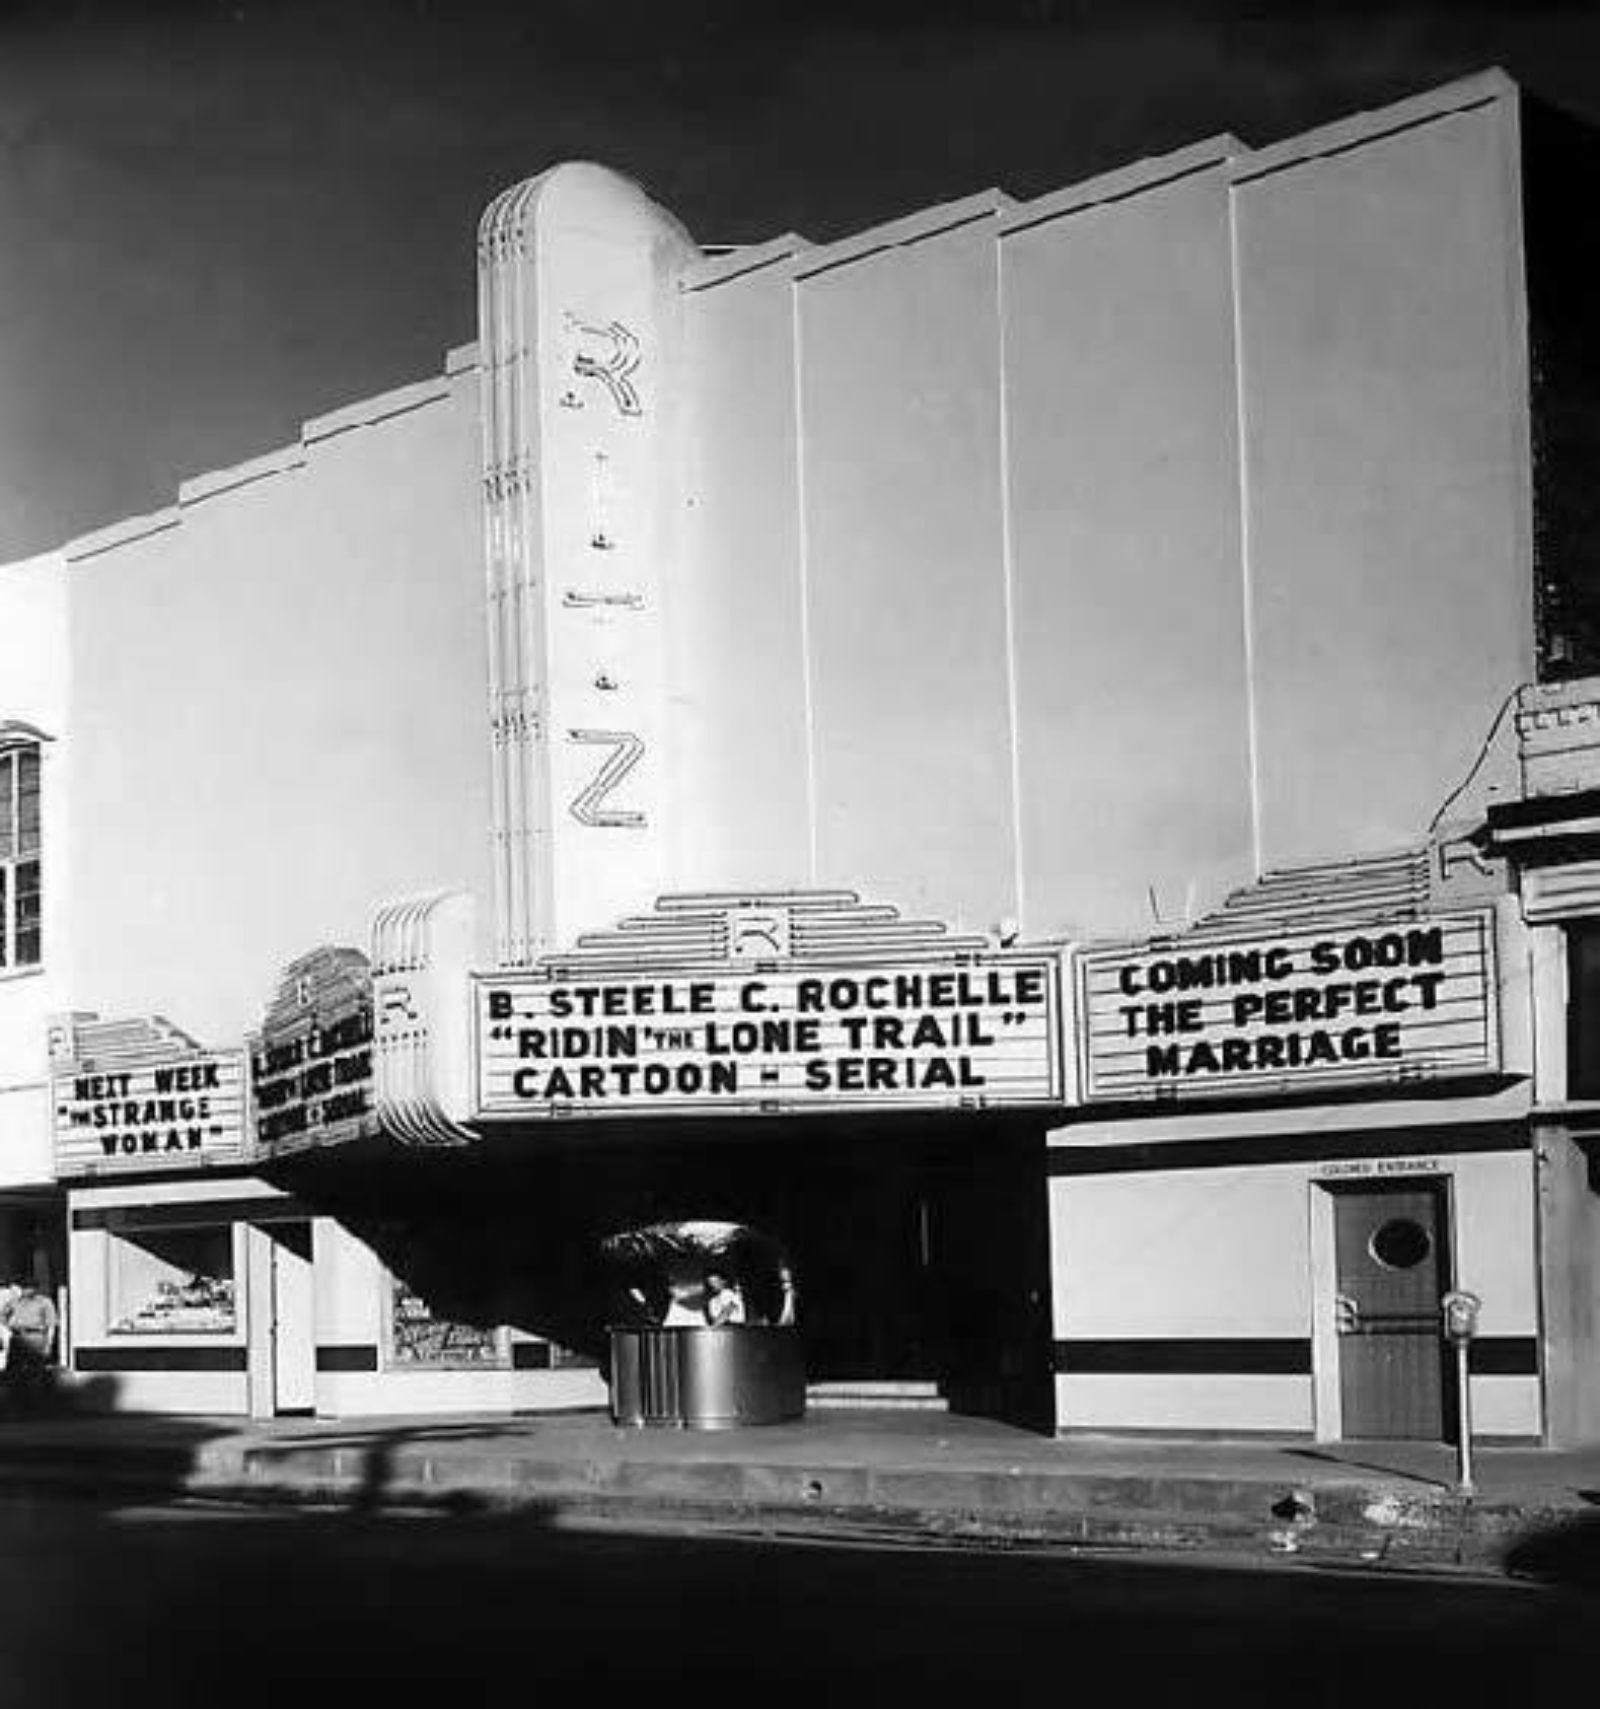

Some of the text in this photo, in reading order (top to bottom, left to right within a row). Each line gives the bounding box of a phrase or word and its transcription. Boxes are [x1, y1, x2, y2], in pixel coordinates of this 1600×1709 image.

[1119, 927, 1443, 997] COMING SOON
[489, 970, 1044, 1019] B. STEELE C. ROCHELLE
[1118, 971, 1446, 1038] THE PERFECT
[652, 1030, 695, 1050] THE
[704, 1019, 822, 1055] LONE
[1145, 1023, 1403, 1078] MARRIAGE
[74, 1072, 132, 1101] NEXT
[154, 1063, 220, 1094] WEEK
[513, 1061, 738, 1098] CARTOON
[804, 1056, 986, 1091] SERIAL
[93, 1098, 211, 1128] STRANGE
